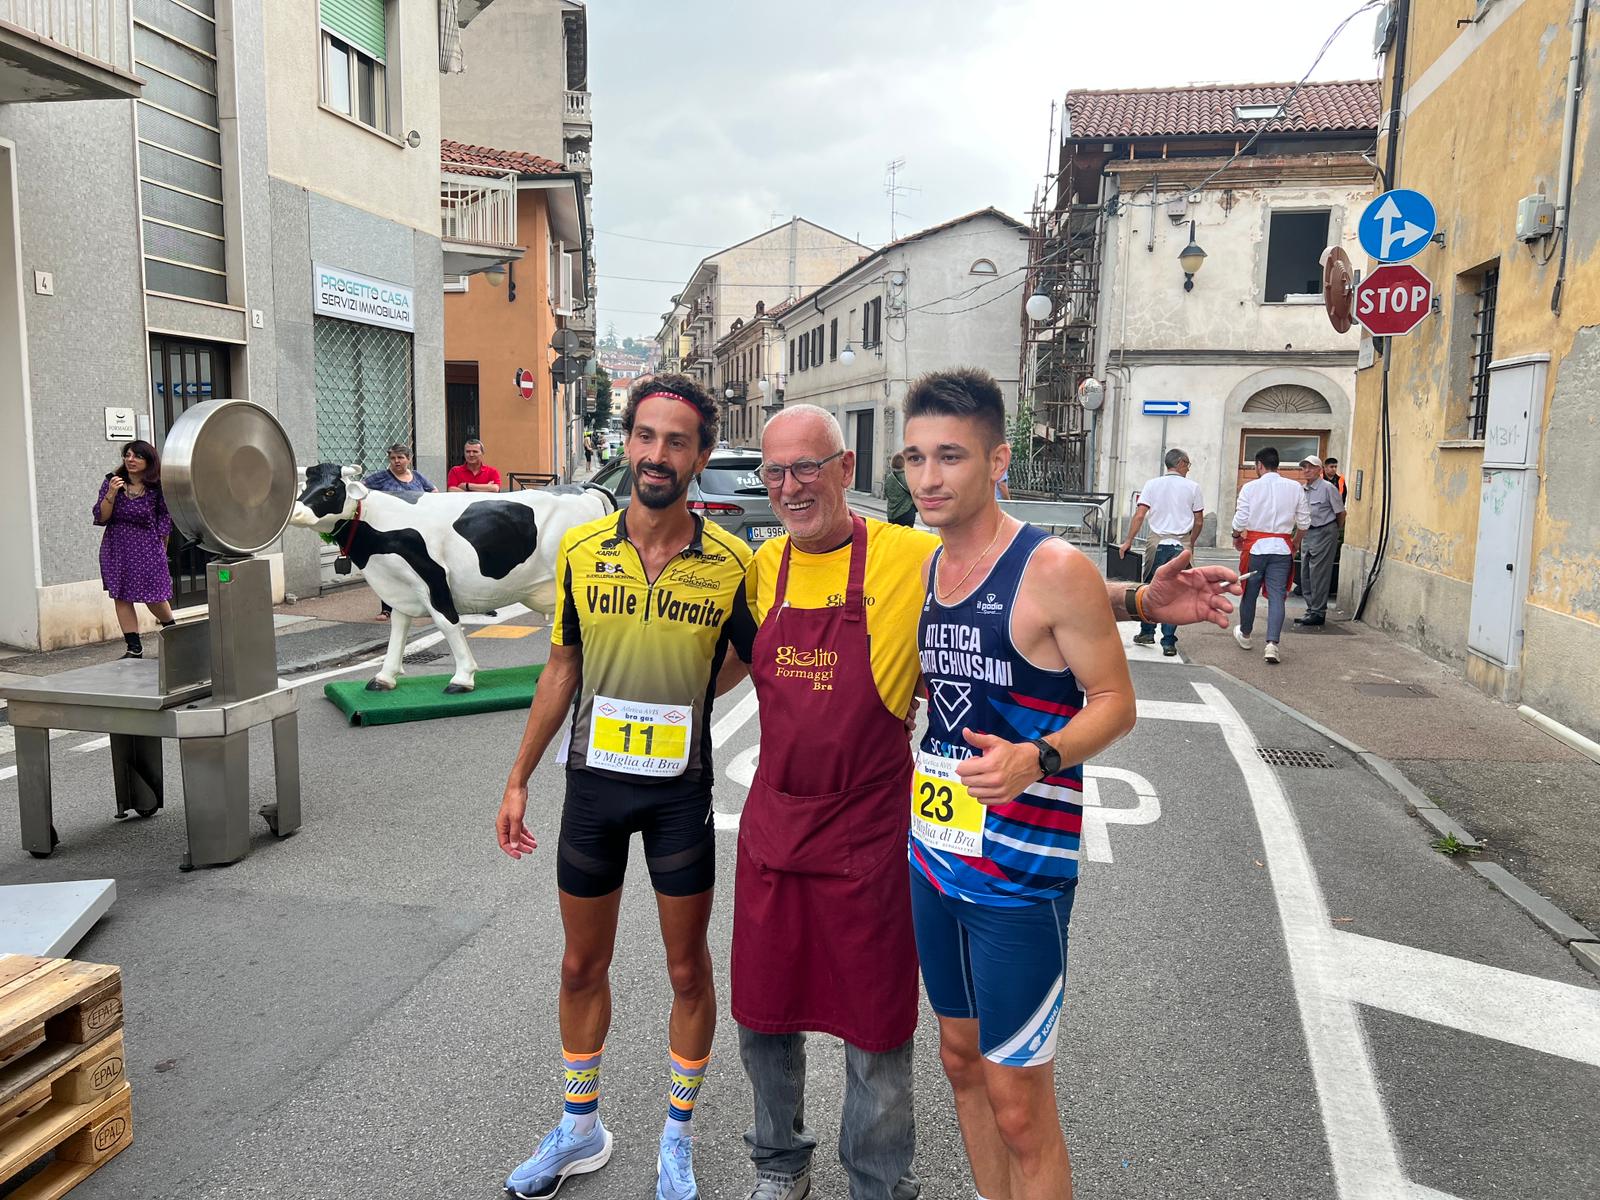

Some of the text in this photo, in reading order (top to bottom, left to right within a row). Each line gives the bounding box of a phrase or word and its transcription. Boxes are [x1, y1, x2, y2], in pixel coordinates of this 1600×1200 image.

[41, 276, 47, 290] 4
[320, 274, 409, 308] PROGETTO CASA
[321, 292, 410, 322] SERVIZI IMMOBILIARI
[1359, 286, 1427, 315] STOP
[753, 527, 765, 538] GL
[586, 585, 725, 628] Valle Varaita
[976, 601, 1003, 611] il podio
[925, 623, 982, 653] ATLETICA
[775, 667, 834, 681] Formaggi
[938, 650, 1014, 687] CHIUSANI
[812, 682, 833, 691] Bra
[625, 712, 638, 720] bra
[618, 723, 654, 755] 11
[594, 749, 601, 759] 9
[602, 752, 639, 767] Miglia
[642, 757, 654, 768] di
[658, 759, 680, 770] Bra
[924, 765, 949, 778] bra gas
[919, 781, 954, 823] 23
[939, 828, 952, 842] di
[954, 830, 976, 848] Bra
[1041, 1005, 1059, 1037] KARHU
[94, 1062, 119, 1088] EPAL
[99, 1123, 122, 1147] EPAL
